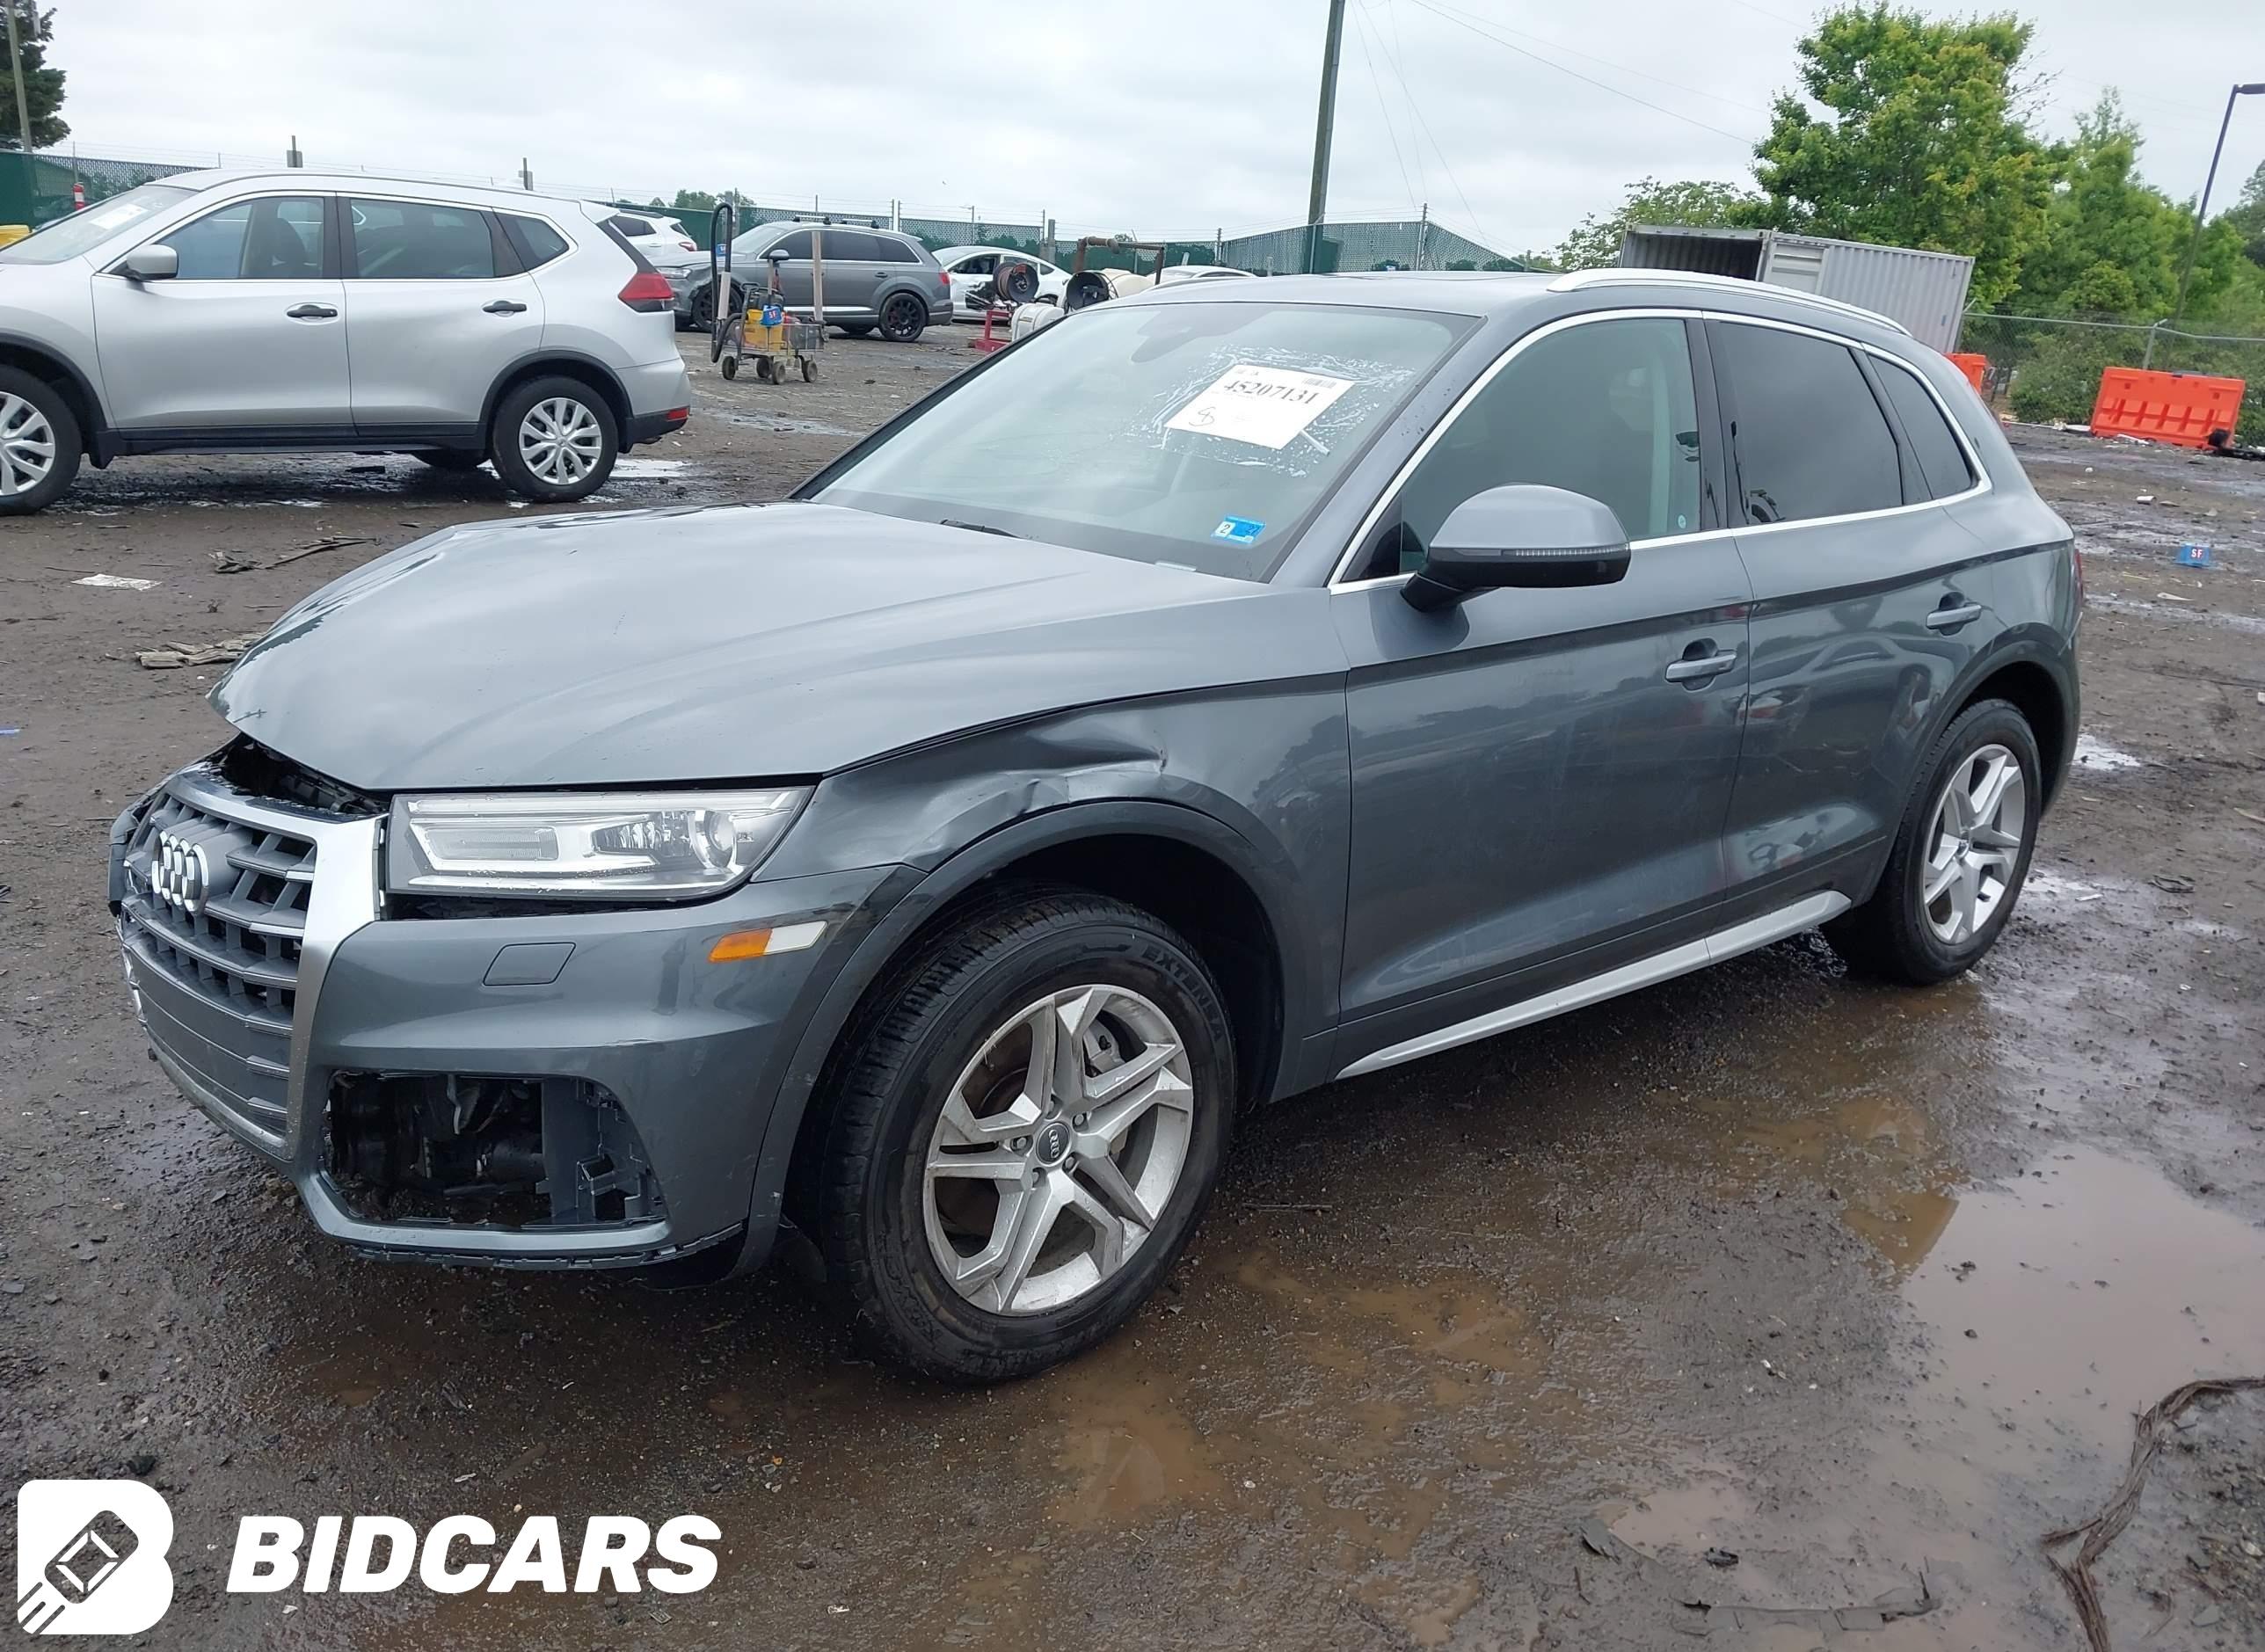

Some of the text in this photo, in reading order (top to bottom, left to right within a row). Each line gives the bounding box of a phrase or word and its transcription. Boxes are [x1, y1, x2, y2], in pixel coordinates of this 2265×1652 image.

[1223, 380, 1320, 404] 45207131
[1220, 523, 1231, 535] 2
[2190, 549, 2203, 558] SF
[1141, 943, 1225, 1044] EXTENSA
